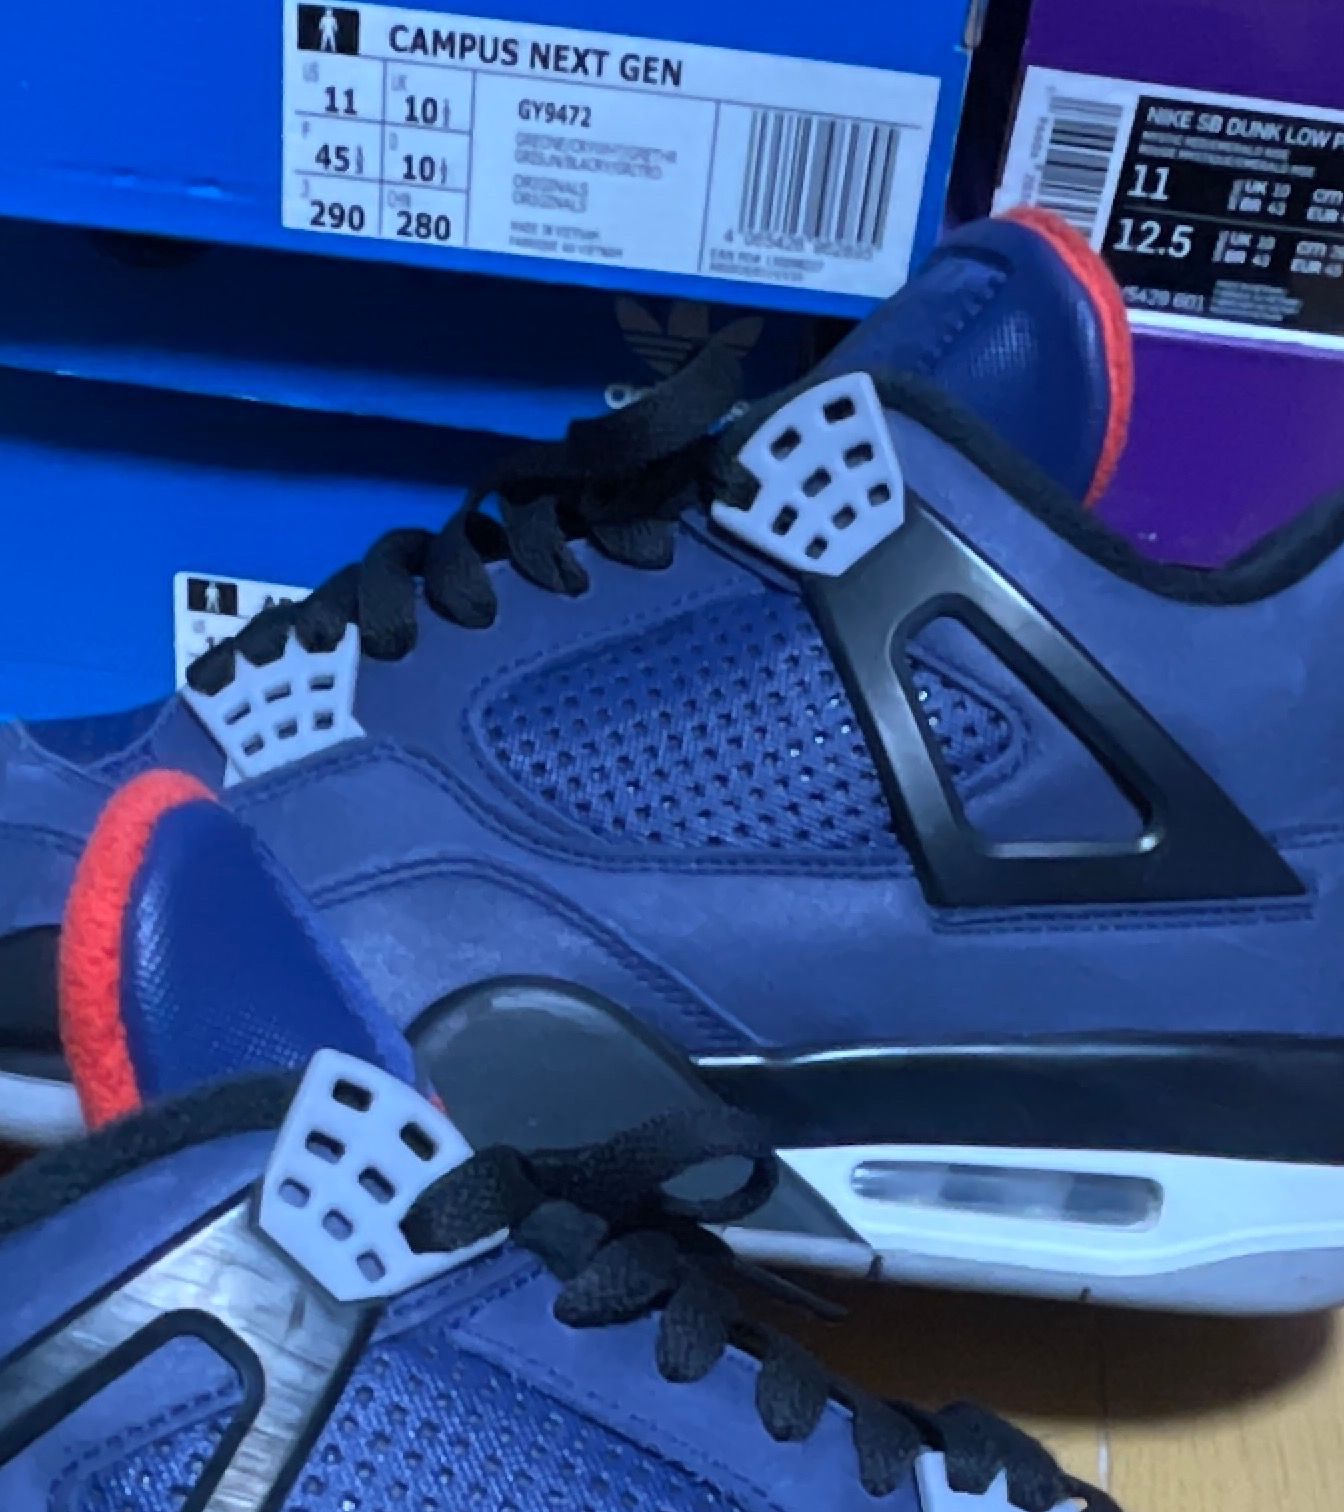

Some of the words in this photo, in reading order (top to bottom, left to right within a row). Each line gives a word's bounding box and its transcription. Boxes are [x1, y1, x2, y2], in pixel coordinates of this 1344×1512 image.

[389, 25, 519, 66] CAMPUS
[529, 42, 610, 77] NEXT
[620, 53, 682, 87] GEN
[324, 86, 357, 115] 11
[518, 98, 592, 128] GY9472
[1147, 106, 1194, 130] NIKE
[1196, 112, 1223, 134] SB
[1226, 117, 1283, 142] DUNK
[1285, 126, 1332, 148] LOW
[1126, 164, 1170, 201] 11
[310, 200, 365, 232] 290
[396, 210, 451, 241] 280
[1113, 218, 1194, 259] 12.5
